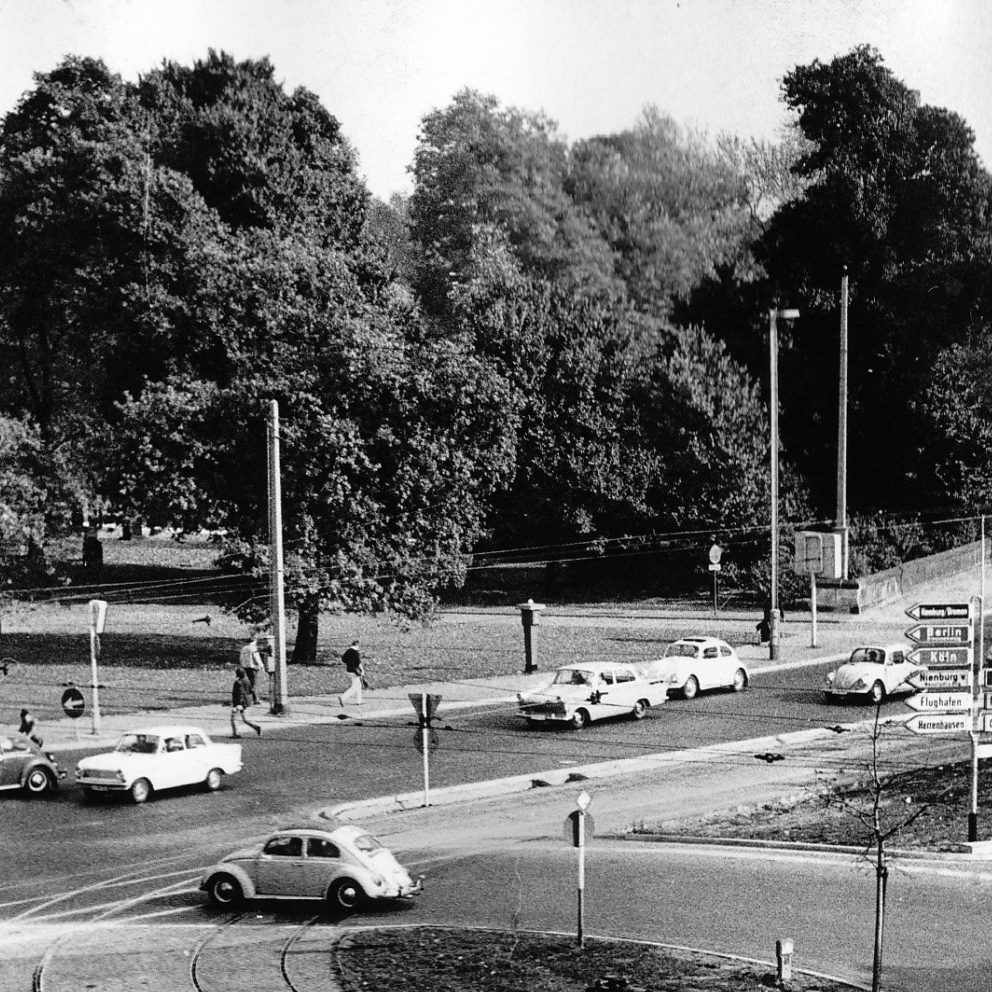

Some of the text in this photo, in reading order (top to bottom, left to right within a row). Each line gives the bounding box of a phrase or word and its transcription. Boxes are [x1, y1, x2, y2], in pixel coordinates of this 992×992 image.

[927, 626, 962, 637] Berlin
[930, 650, 957, 662] Köln
[919, 672, 958, 682] Nienburg
[920, 696, 962, 708] Flughafen
